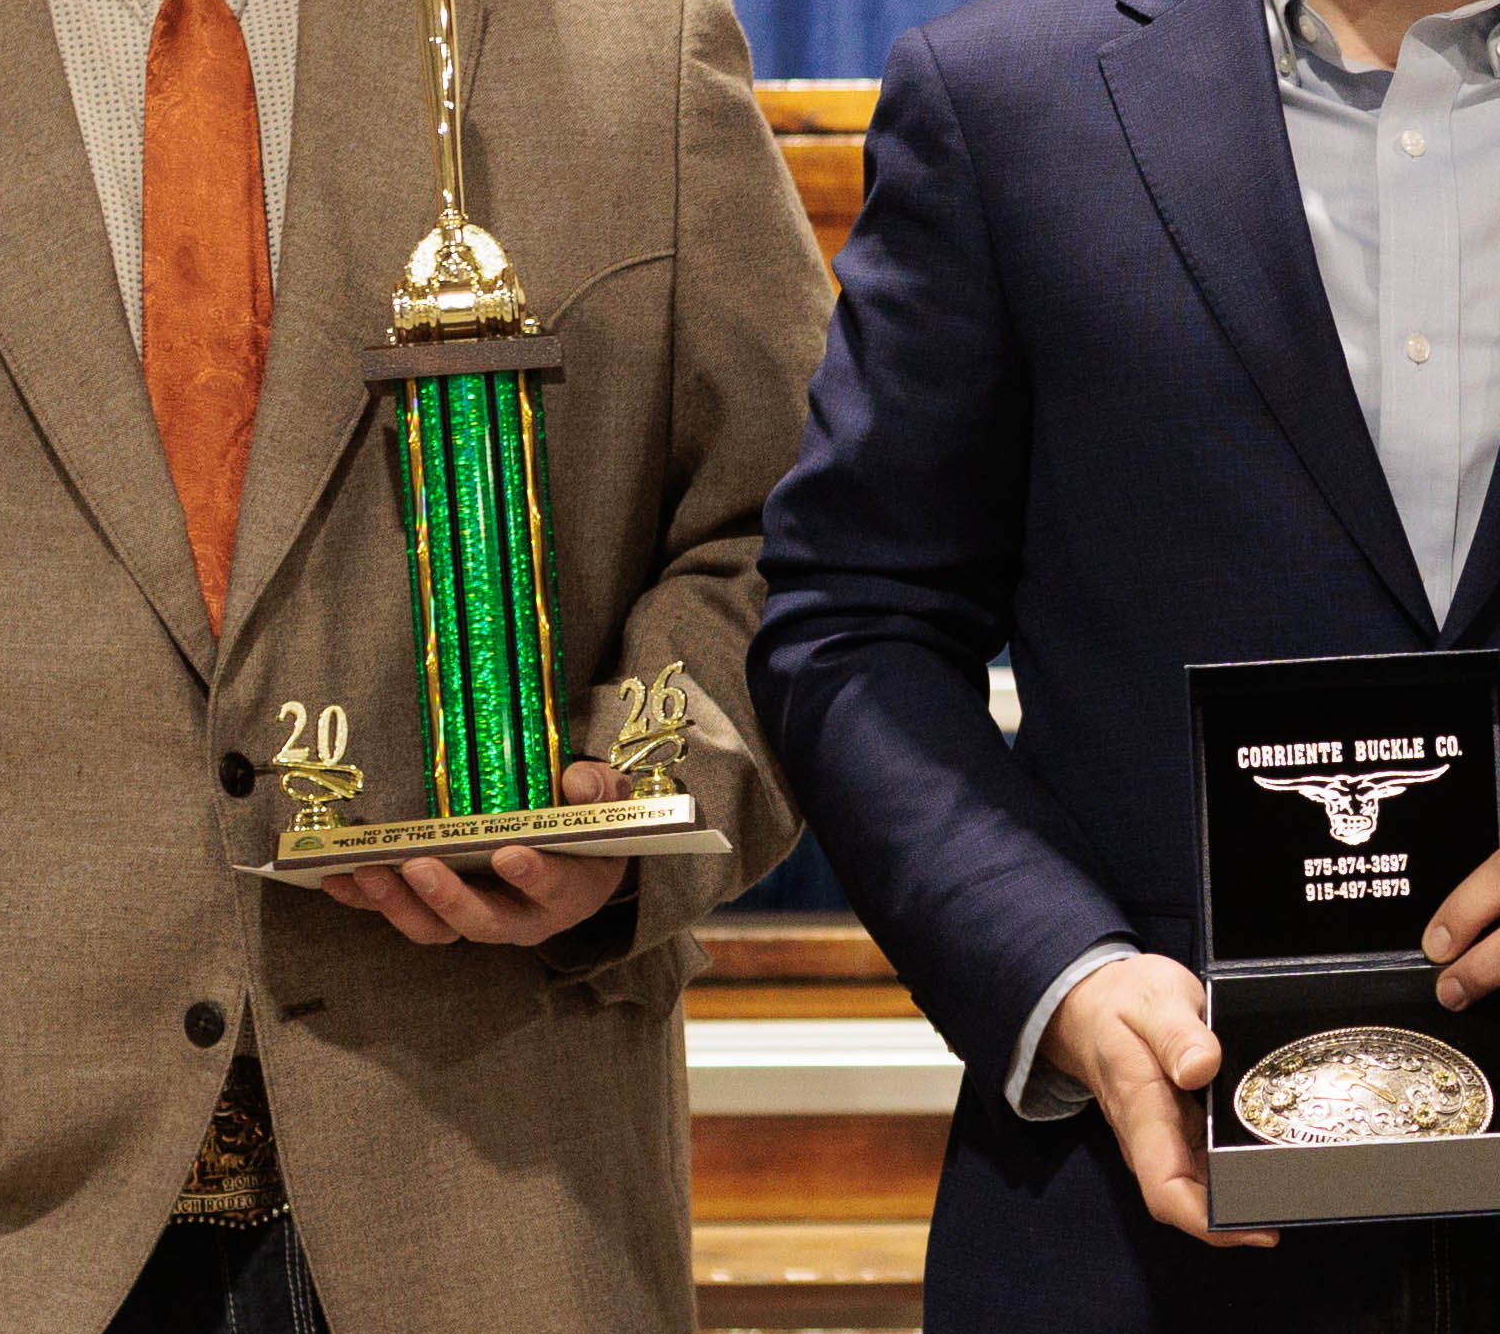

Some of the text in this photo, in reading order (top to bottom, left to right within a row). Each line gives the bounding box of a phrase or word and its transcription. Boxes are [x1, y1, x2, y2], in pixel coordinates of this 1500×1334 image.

[619, 660, 687, 739] 26
[274, 700, 348, 766] 20
[1237, 735, 1463, 768] CORRIENTE BUCKLE CO.
[332, 808, 675, 848] "KING OF THE SALE RING" BID CALL CONTEST
[385, 824, 435, 834] WINTER
[438, 819, 478, 830] SHOW
[481, 814, 543, 826] PEOPLE'S
[547, 810, 595, 820] CHOICE
[599, 804, 646, 814] AWARD
[1303, 853, 1409, 877] 575-874-3697
[1305, 878, 1411, 901] 915-497-5579
[204, 1194, 256, 1214] RODEO
